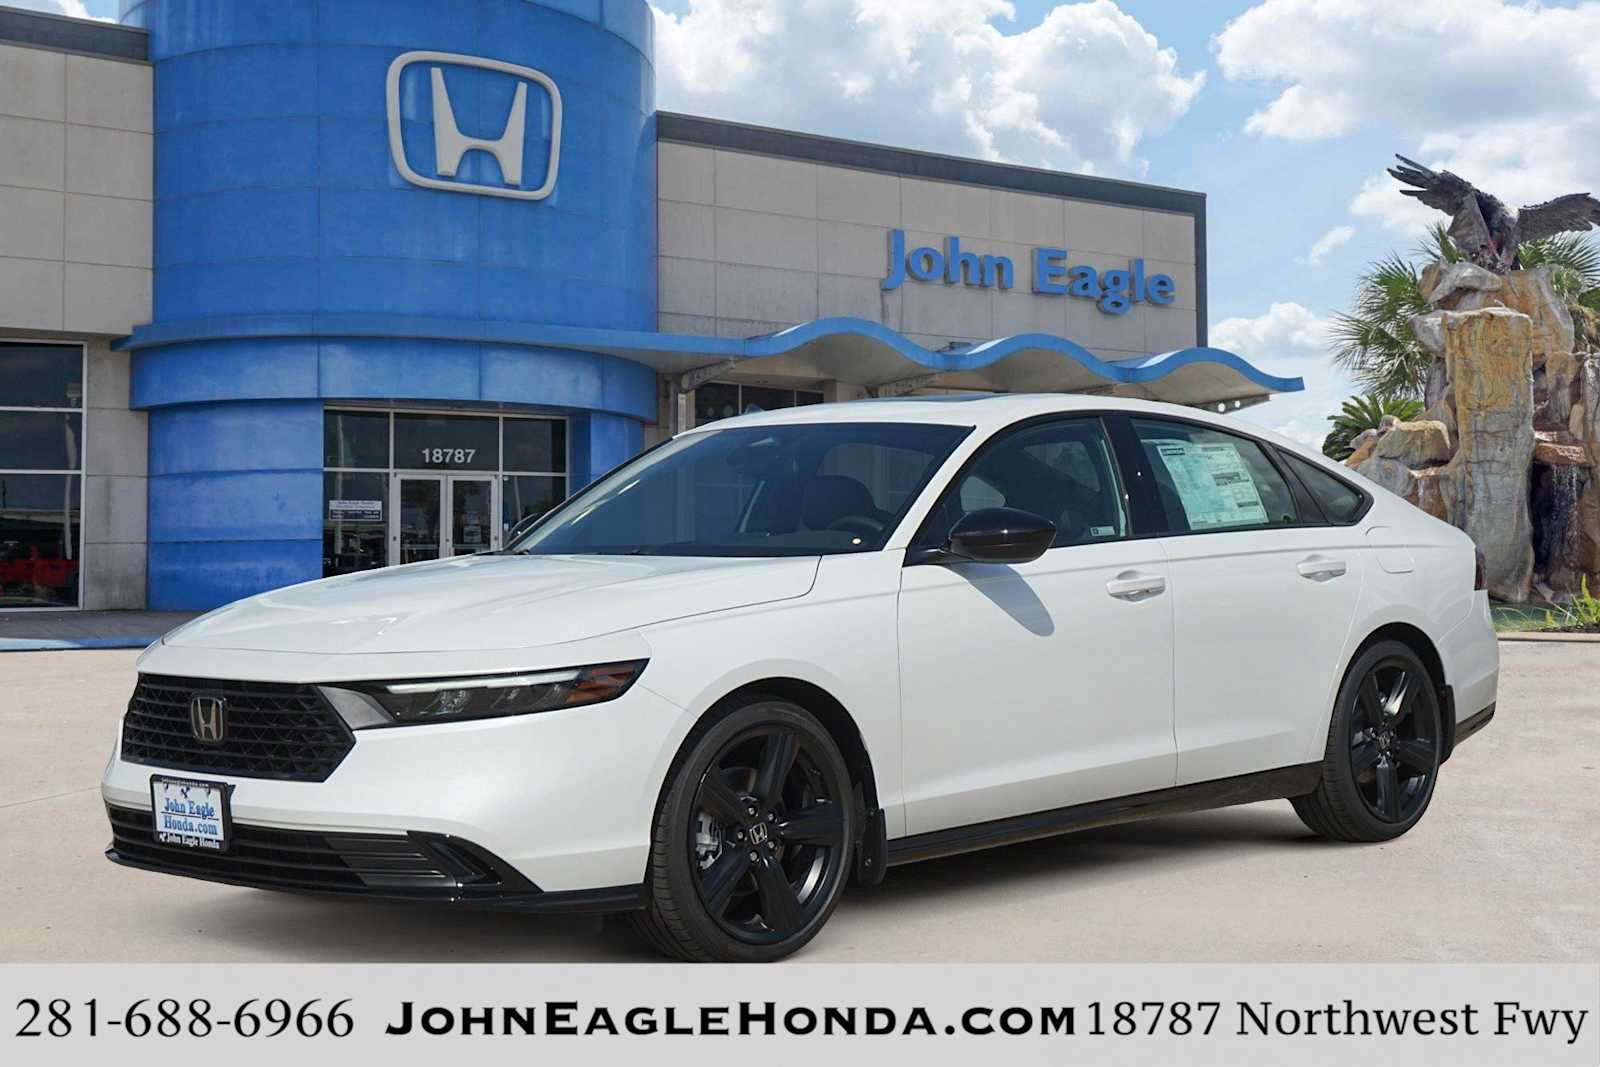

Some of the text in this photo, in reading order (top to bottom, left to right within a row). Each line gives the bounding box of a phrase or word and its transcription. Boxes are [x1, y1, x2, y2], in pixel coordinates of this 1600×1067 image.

[881, 228, 1176, 315] John Eagle
[422, 447, 476, 464] 18787
[164, 797, 215, 820] John Eagle
[164, 814, 218, 836] Honda.com
